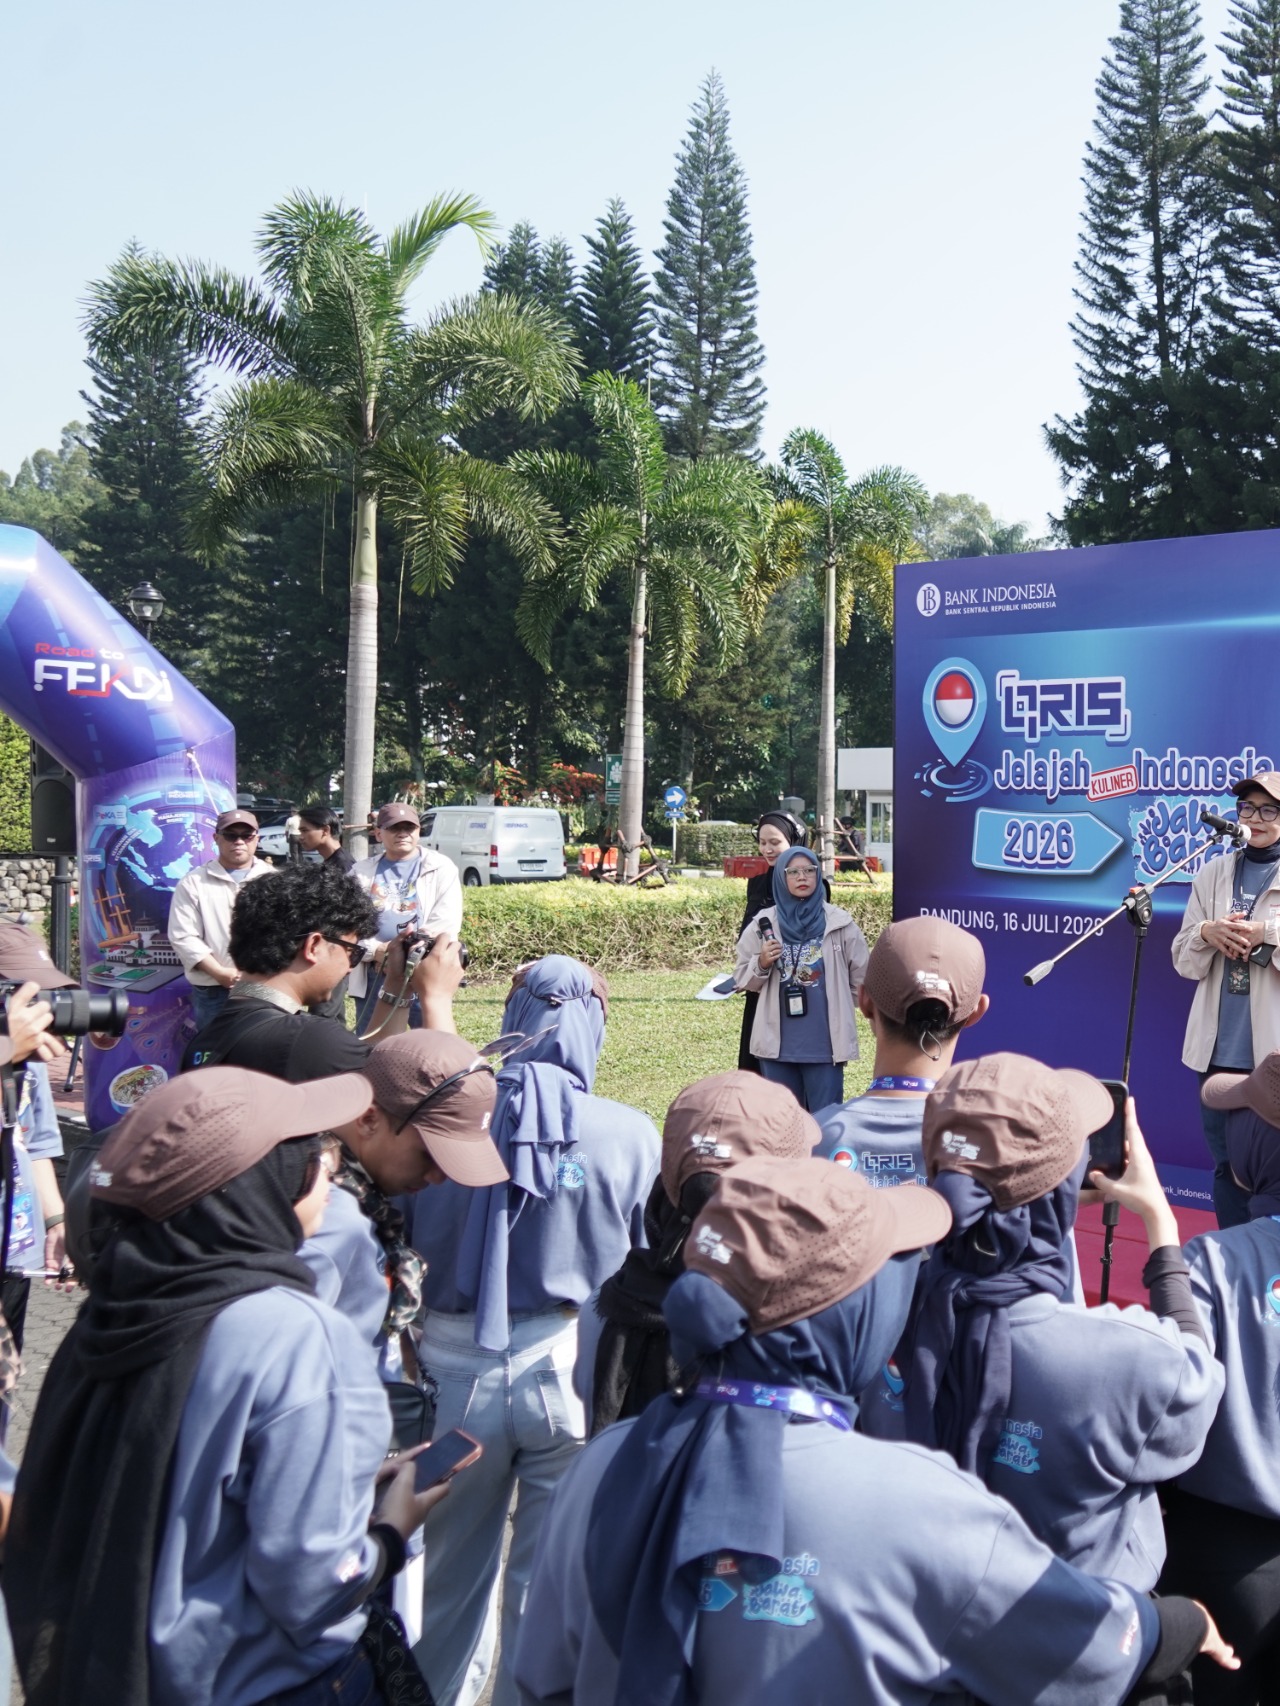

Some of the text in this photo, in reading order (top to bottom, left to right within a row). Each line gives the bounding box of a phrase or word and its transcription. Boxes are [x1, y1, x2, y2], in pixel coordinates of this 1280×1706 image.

[945, 582, 1057, 606] BANK INDONESIA
[945, 601, 1057, 616] BANK SENTRAL REPUBLIK INDONESIA
[35, 642, 125, 660] Road to
[998, 673, 1130, 742] QRIS
[996, 749, 1091, 800] Jelajah
[1091, 772, 1134, 796] KULINER
[1003, 819, 1075, 863] 2026
[1003, 912, 1018, 931] 16
[1022, 914, 1059, 934] JULI
[862, 1151, 915, 1174] QRIS
